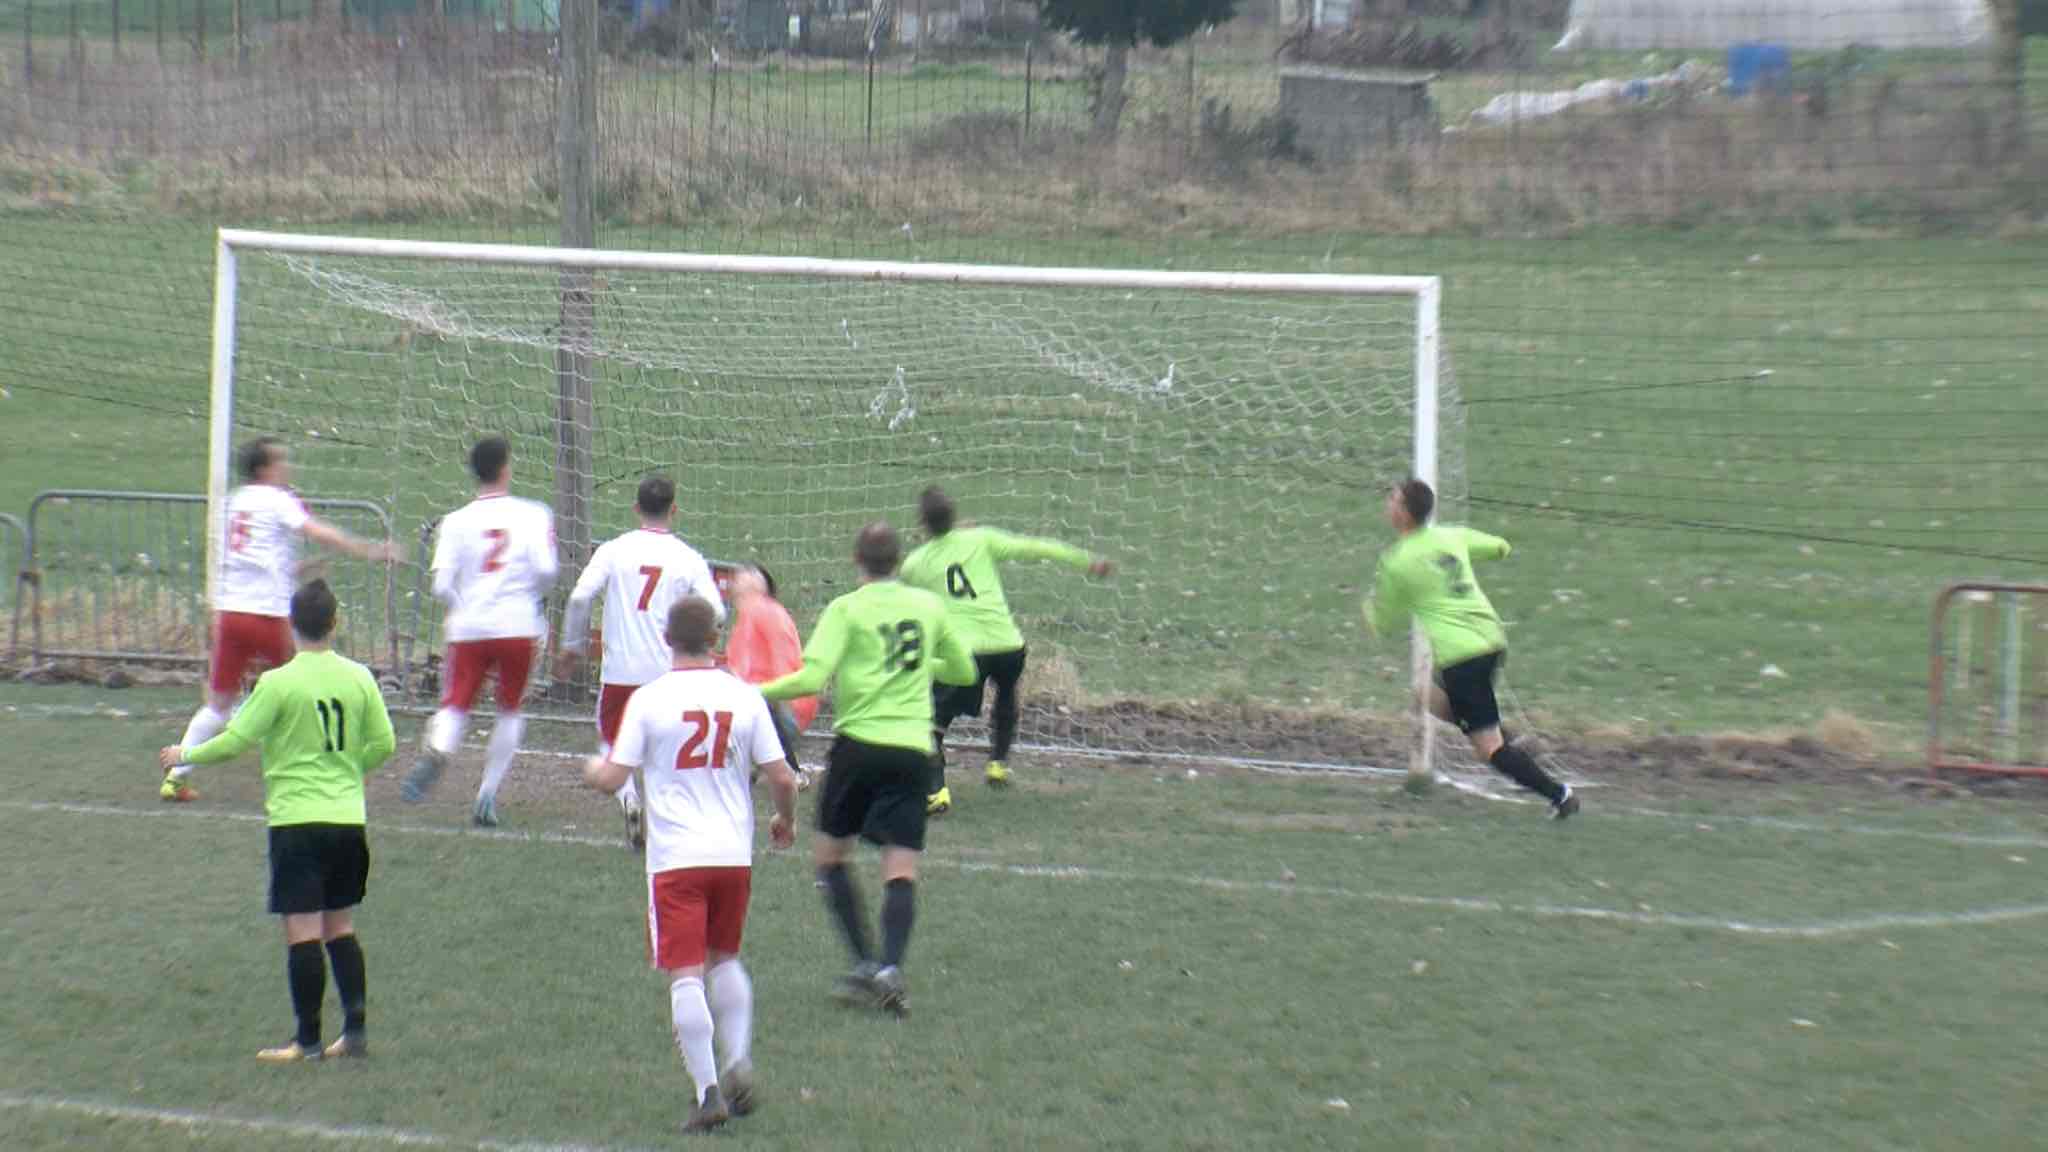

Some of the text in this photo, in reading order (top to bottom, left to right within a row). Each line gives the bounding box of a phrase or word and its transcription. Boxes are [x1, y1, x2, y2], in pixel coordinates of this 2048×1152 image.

[481, 528, 511, 573] 2
[638, 565, 662, 611] 7
[878, 619, 924, 672] 18
[317, 697, 344, 752] 11
[676, 710, 733, 770] 21
